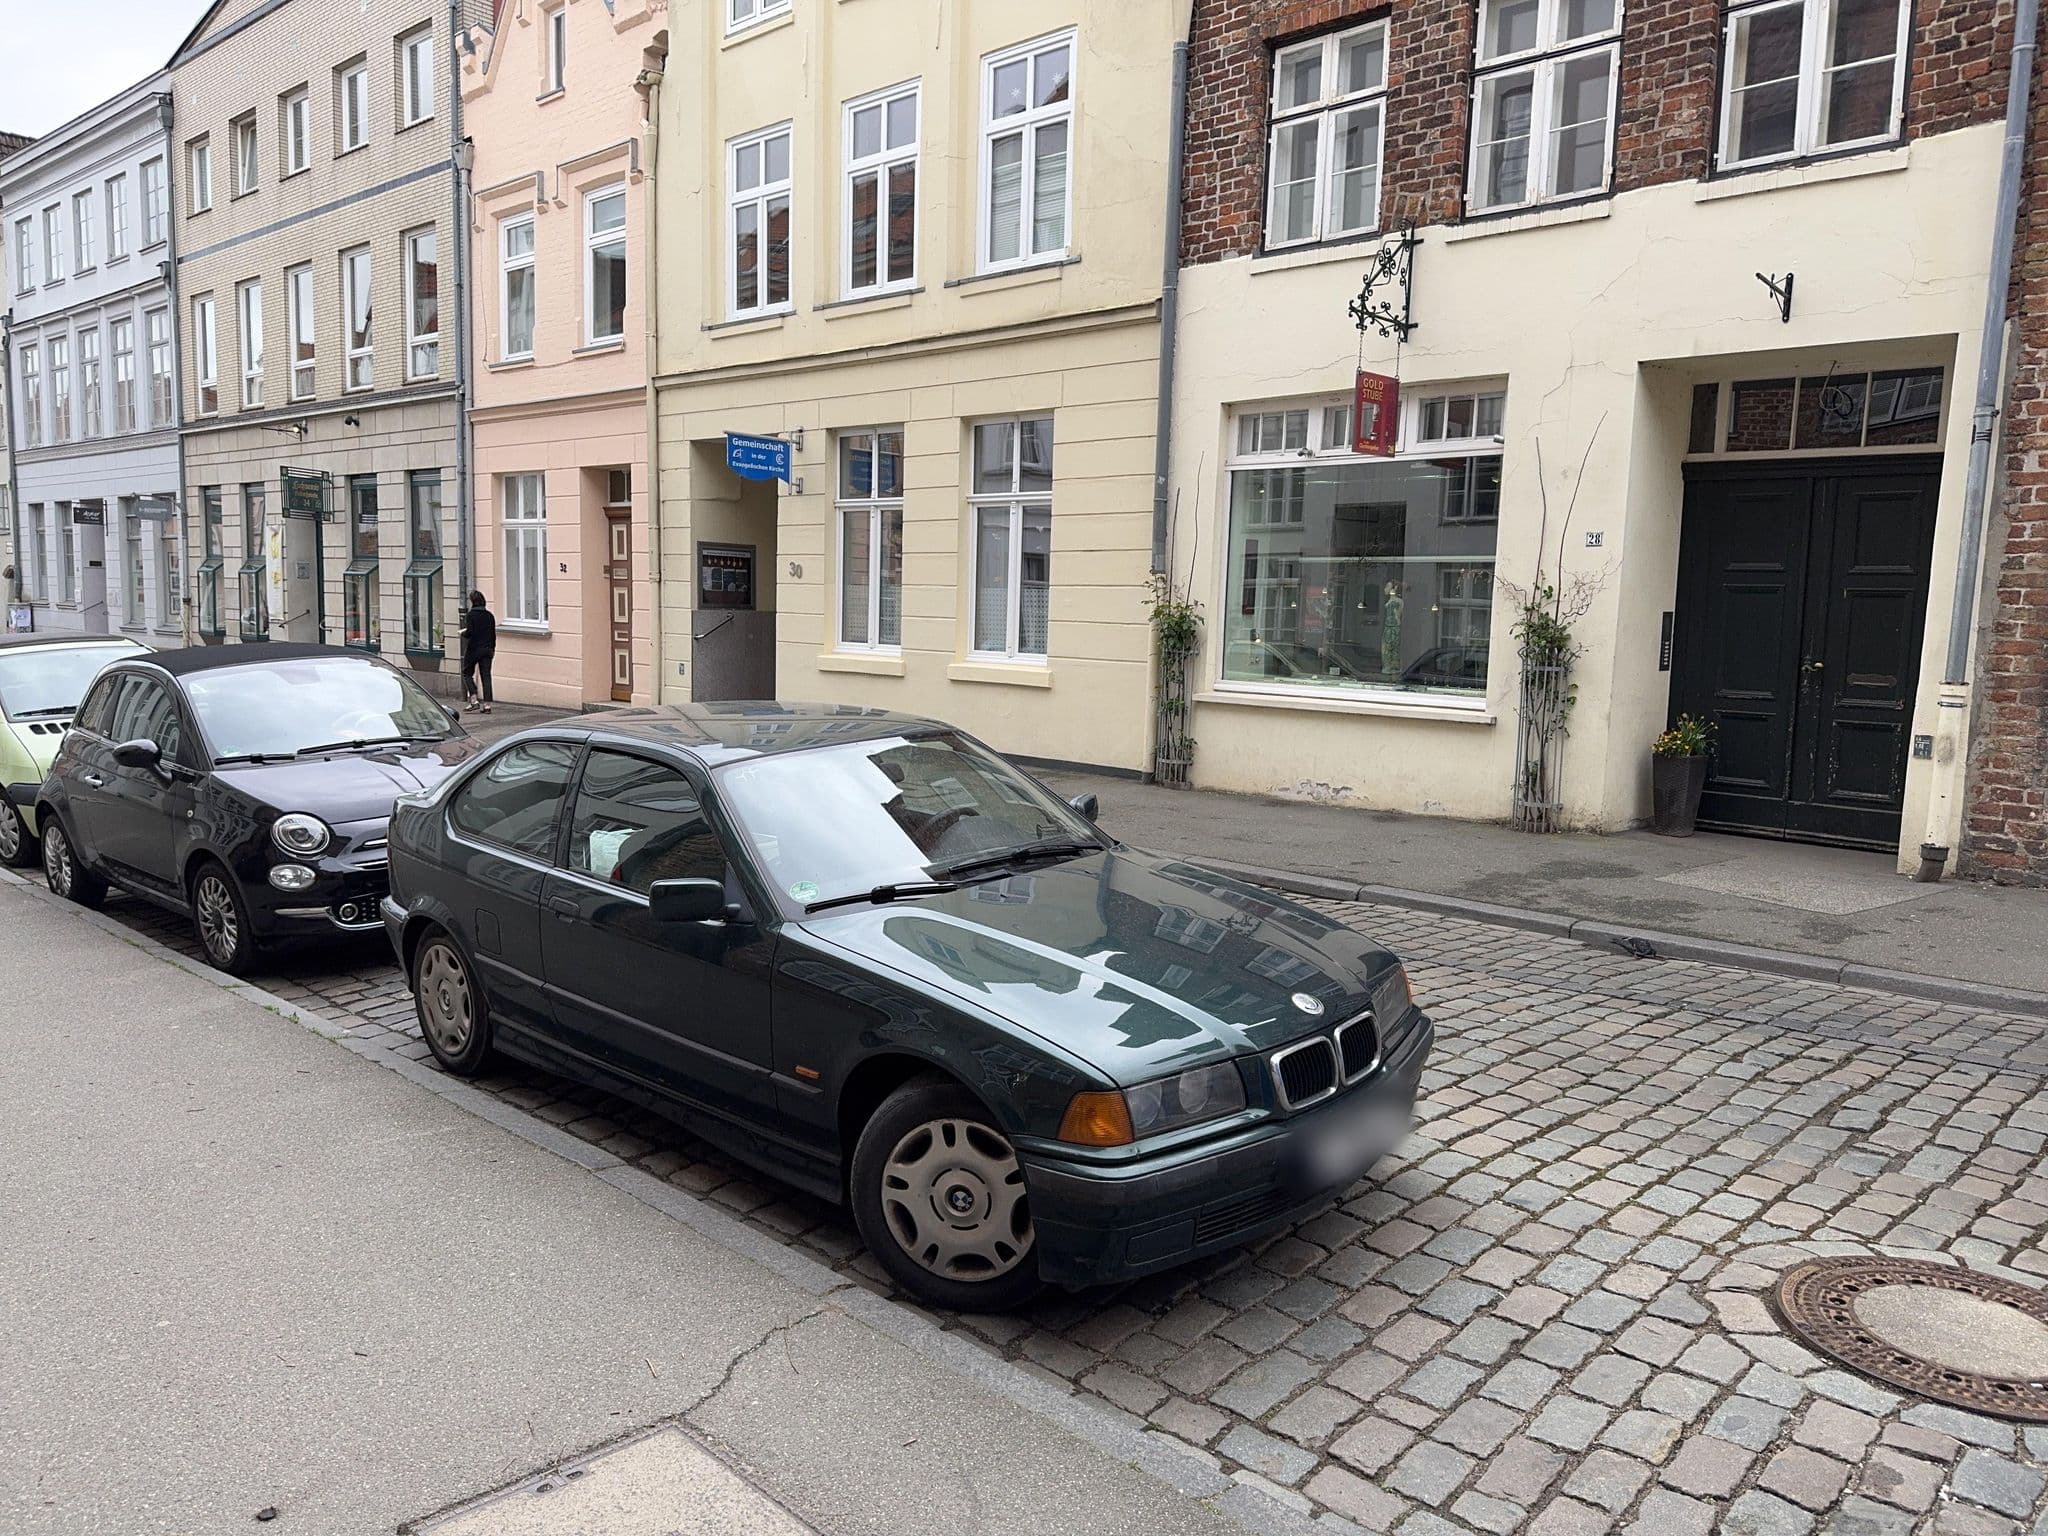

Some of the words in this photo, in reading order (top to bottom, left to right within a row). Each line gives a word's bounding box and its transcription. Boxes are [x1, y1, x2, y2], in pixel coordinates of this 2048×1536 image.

[1363, 377, 1384, 390] GOLD
[1362, 388, 1383, 401] STUBE
[732, 437, 784, 452] Gemeinschaft
[732, 461, 769, 471] Evangelischen
[768, 465, 784, 473] Kirche
[1588, 534, 1600, 545] 28
[559, 562, 567, 573] 32
[788, 561, 803, 579] 30
